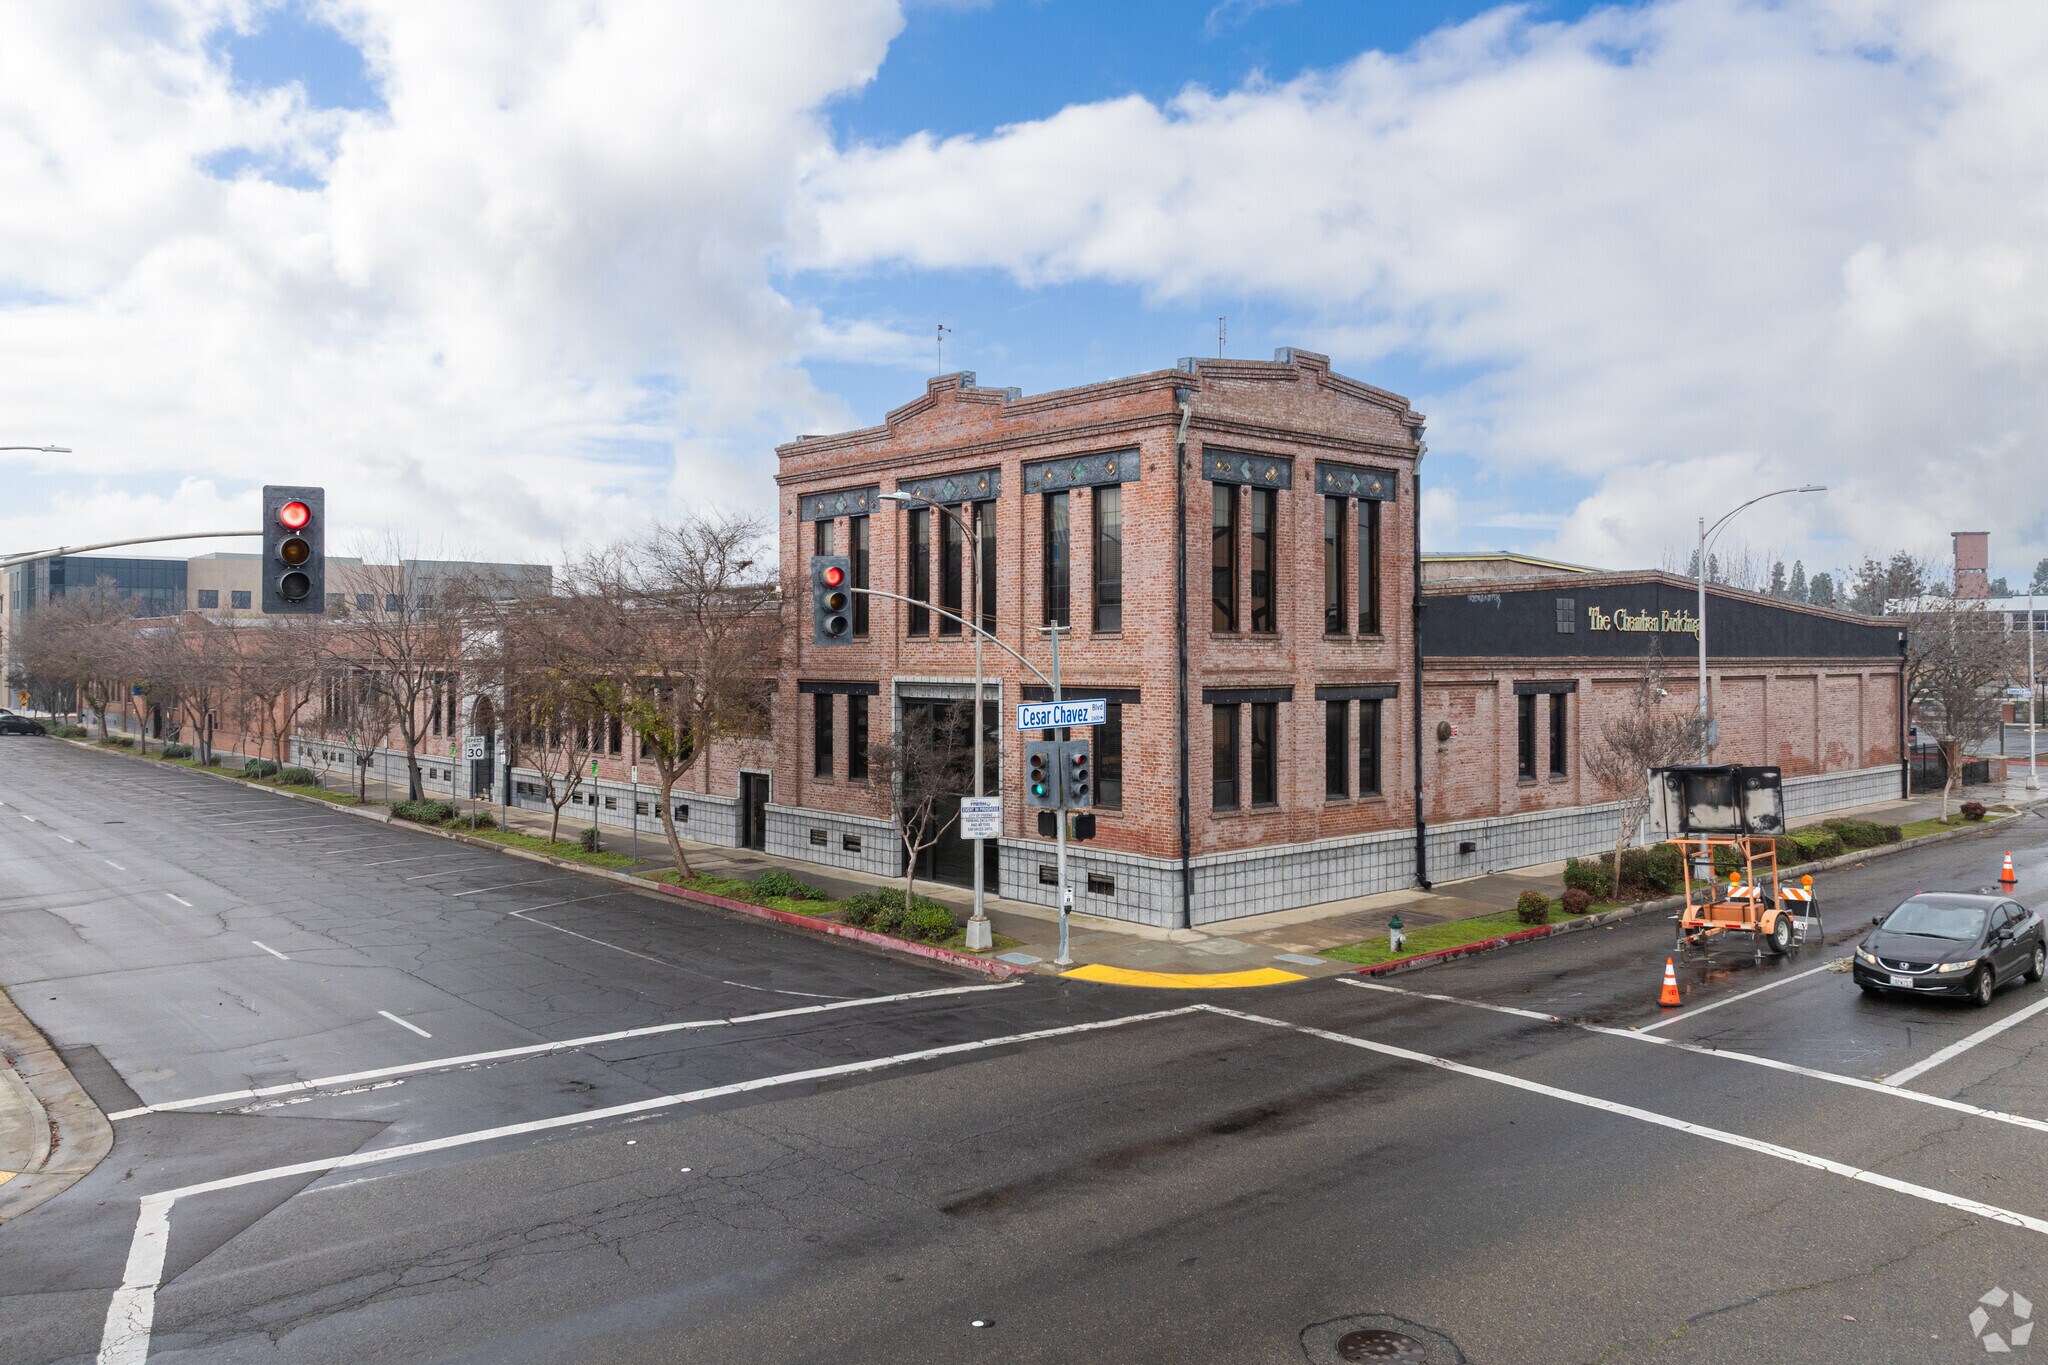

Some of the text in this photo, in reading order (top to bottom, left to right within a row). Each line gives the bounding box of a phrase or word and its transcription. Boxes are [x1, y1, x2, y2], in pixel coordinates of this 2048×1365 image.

[1588, 606, 1611, 631] The
[1092, 703, 1103, 711] Blvd
[1023, 705, 1088, 726] Cesar Chavez
[468, 748, 482, 758] 30
